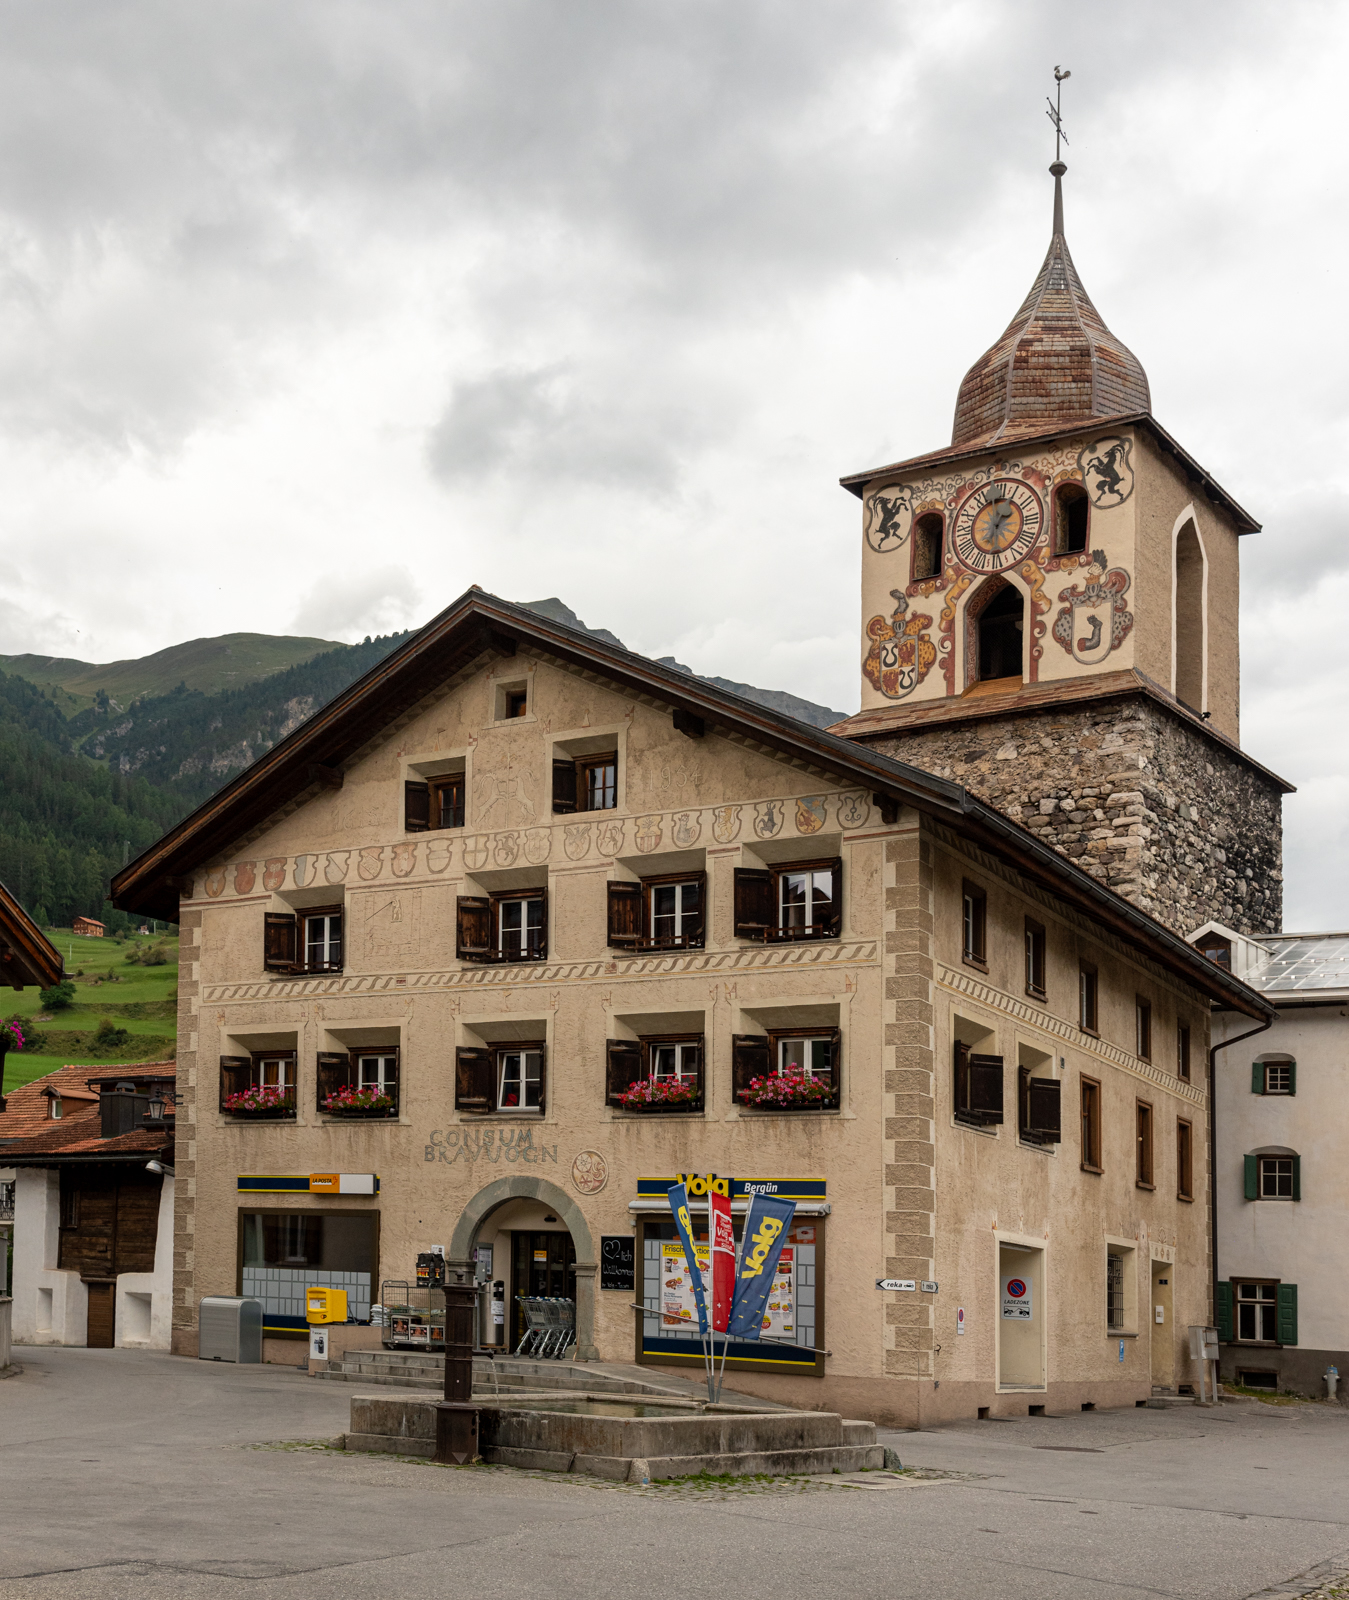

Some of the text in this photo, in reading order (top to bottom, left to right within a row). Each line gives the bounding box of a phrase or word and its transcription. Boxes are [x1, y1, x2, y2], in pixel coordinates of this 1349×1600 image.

[649, 763, 702, 792] 1954
[429, 1128, 534, 1147] CONSUM
[424, 1145, 558, 1164] BRAVUOGN
[676, 1173, 729, 1198] Volg
[744, 1182, 778, 1194] Bergün
[741, 1216, 783, 1279] Volg
